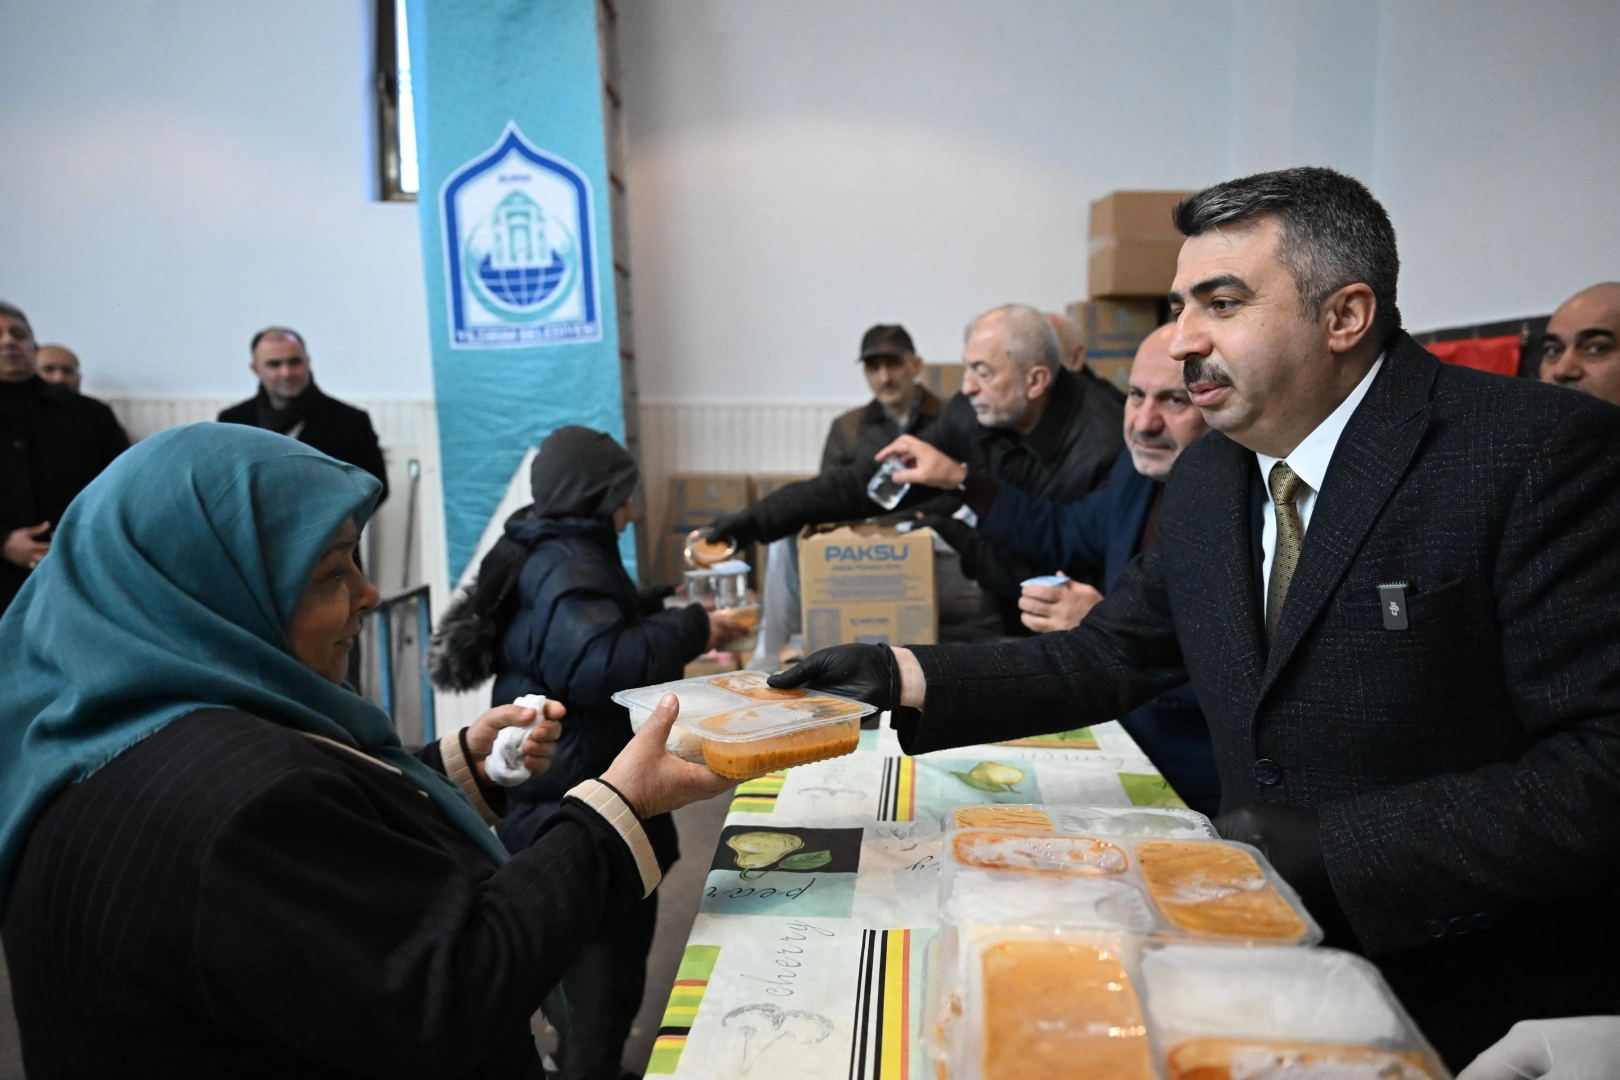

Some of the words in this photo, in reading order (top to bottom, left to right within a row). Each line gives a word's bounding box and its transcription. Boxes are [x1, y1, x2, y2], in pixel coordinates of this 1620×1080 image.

[825, 544, 909, 562] PAKSU
[706, 877, 816, 899] pear
[740, 919, 835, 997] cherry
